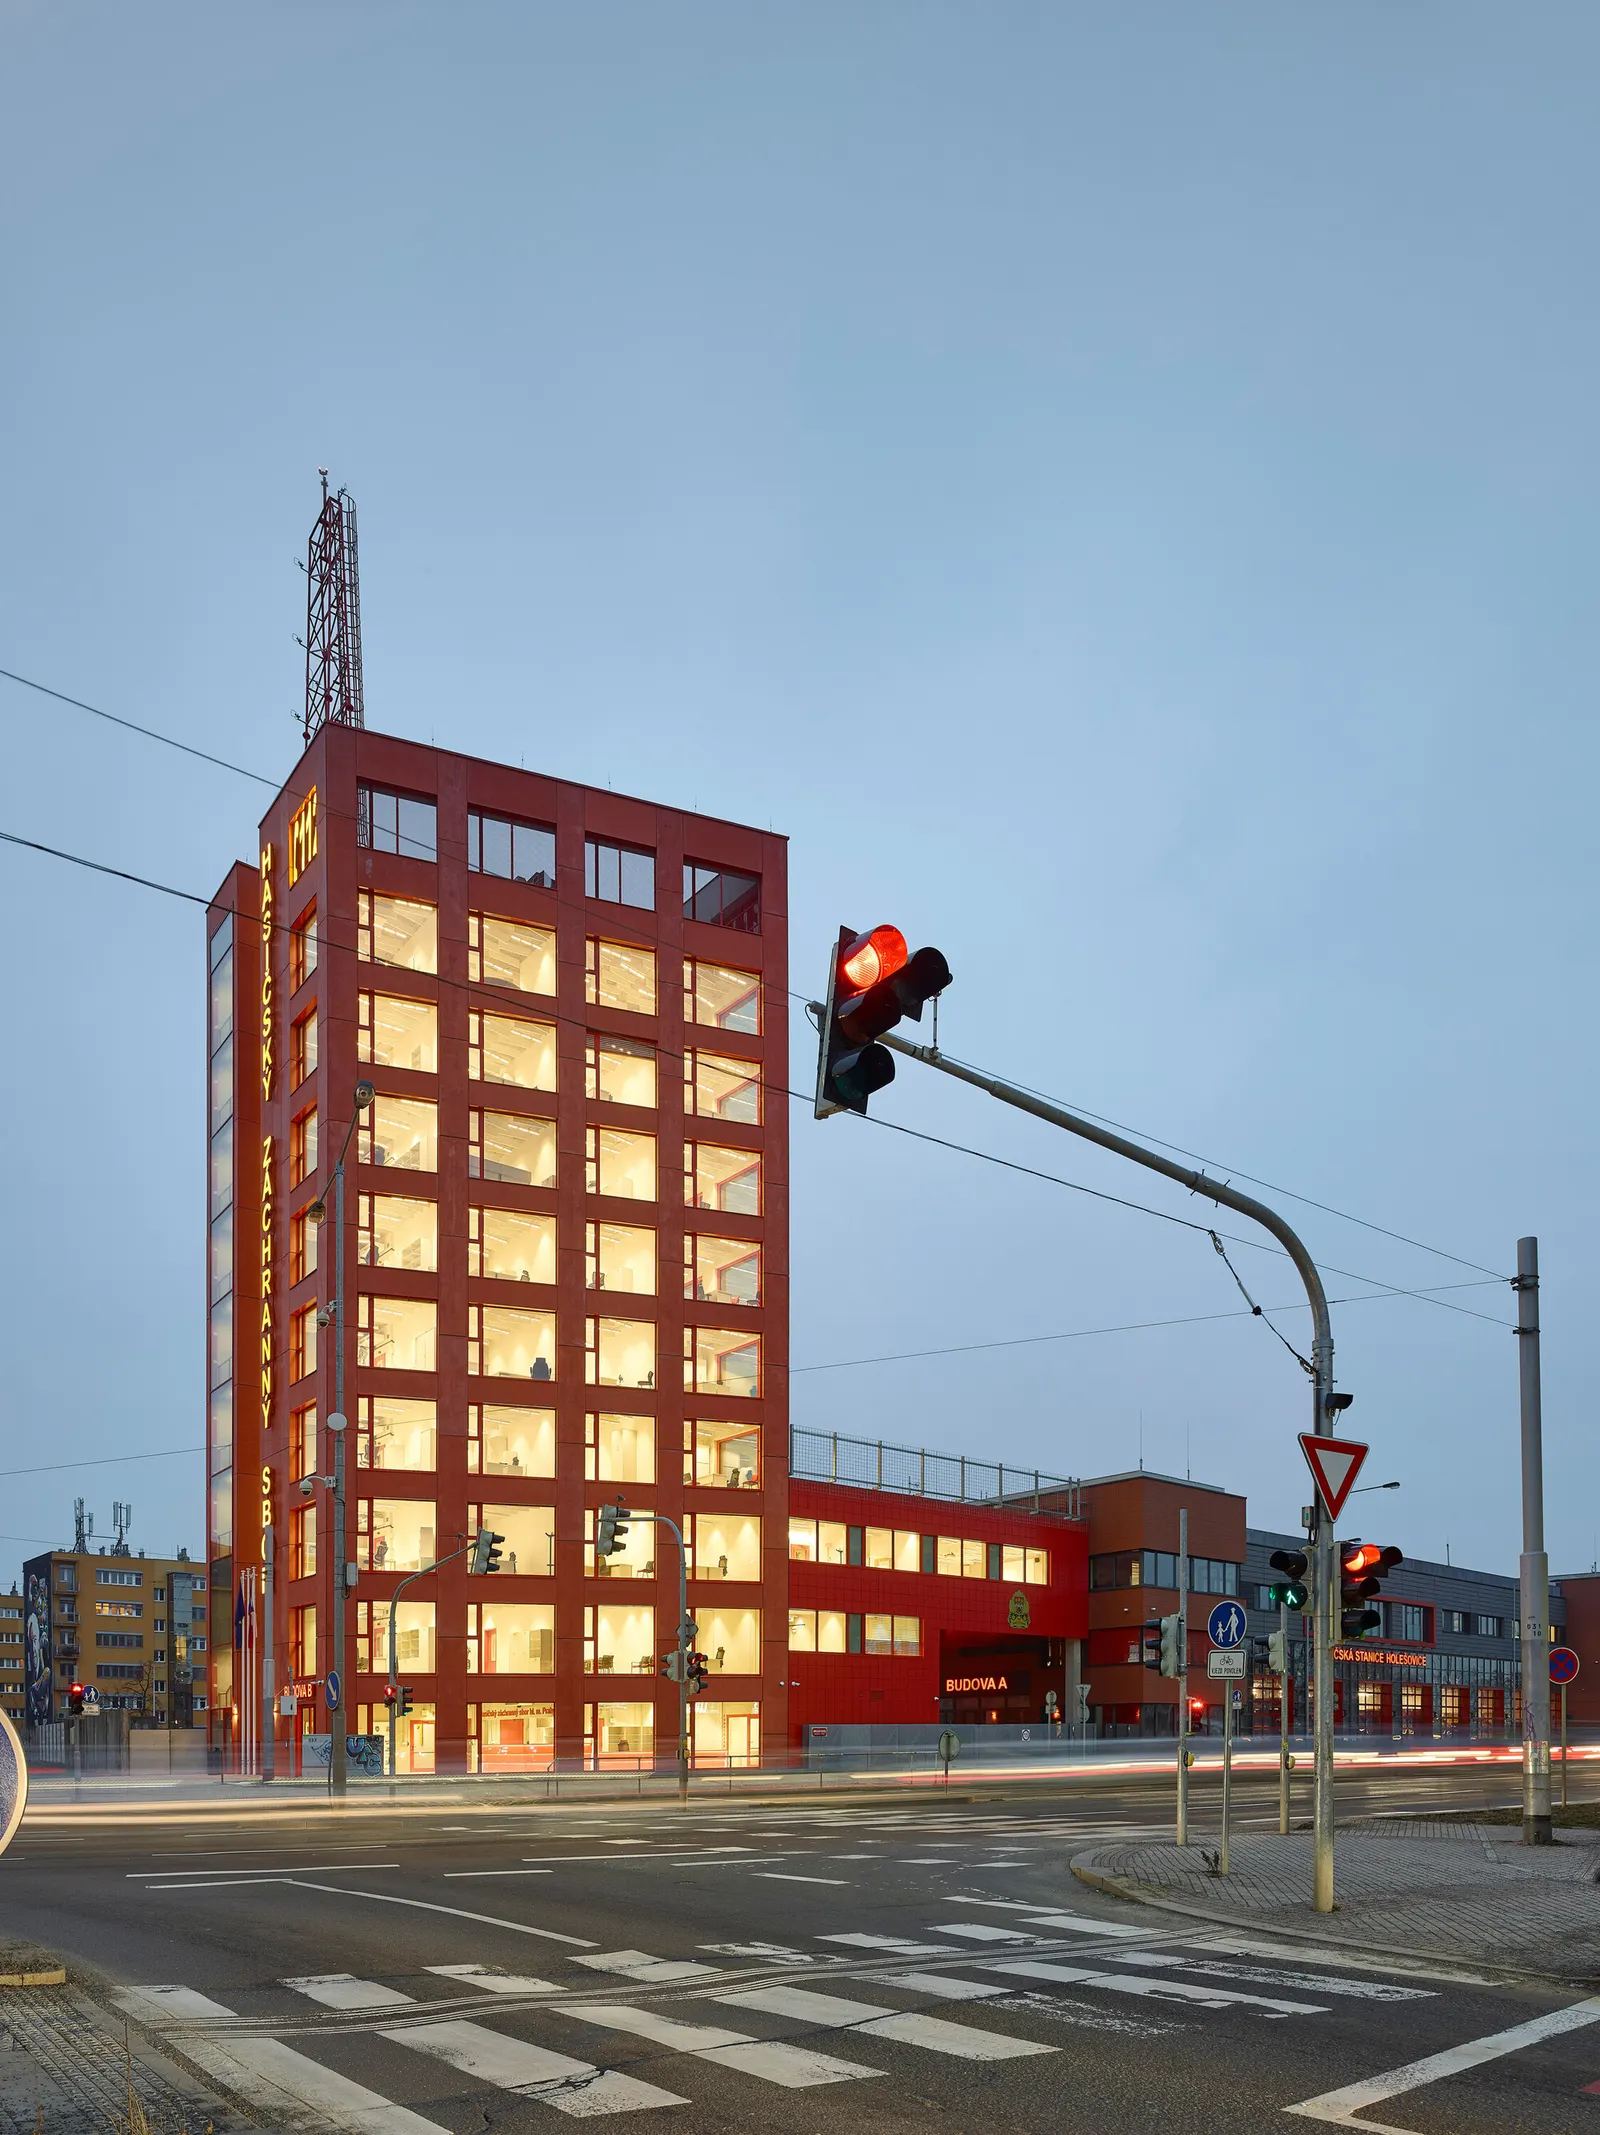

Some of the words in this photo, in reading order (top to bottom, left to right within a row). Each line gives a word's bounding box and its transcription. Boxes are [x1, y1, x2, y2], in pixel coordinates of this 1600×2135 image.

[1333, 1646, 1354, 1661] ČSKÁ
[1355, 1650, 1384, 1664] STANICE
[1386, 1652, 1427, 1667] HOLEŠOVICE
[1210, 1667, 1223, 1675] VJEZD
[1223, 1667, 1242, 1675] POVOLEN
[307, 1683, 313, 1698] B
[946, 1677, 996, 1692] BUDOVA
[997, 1676, 1008, 1690] A
